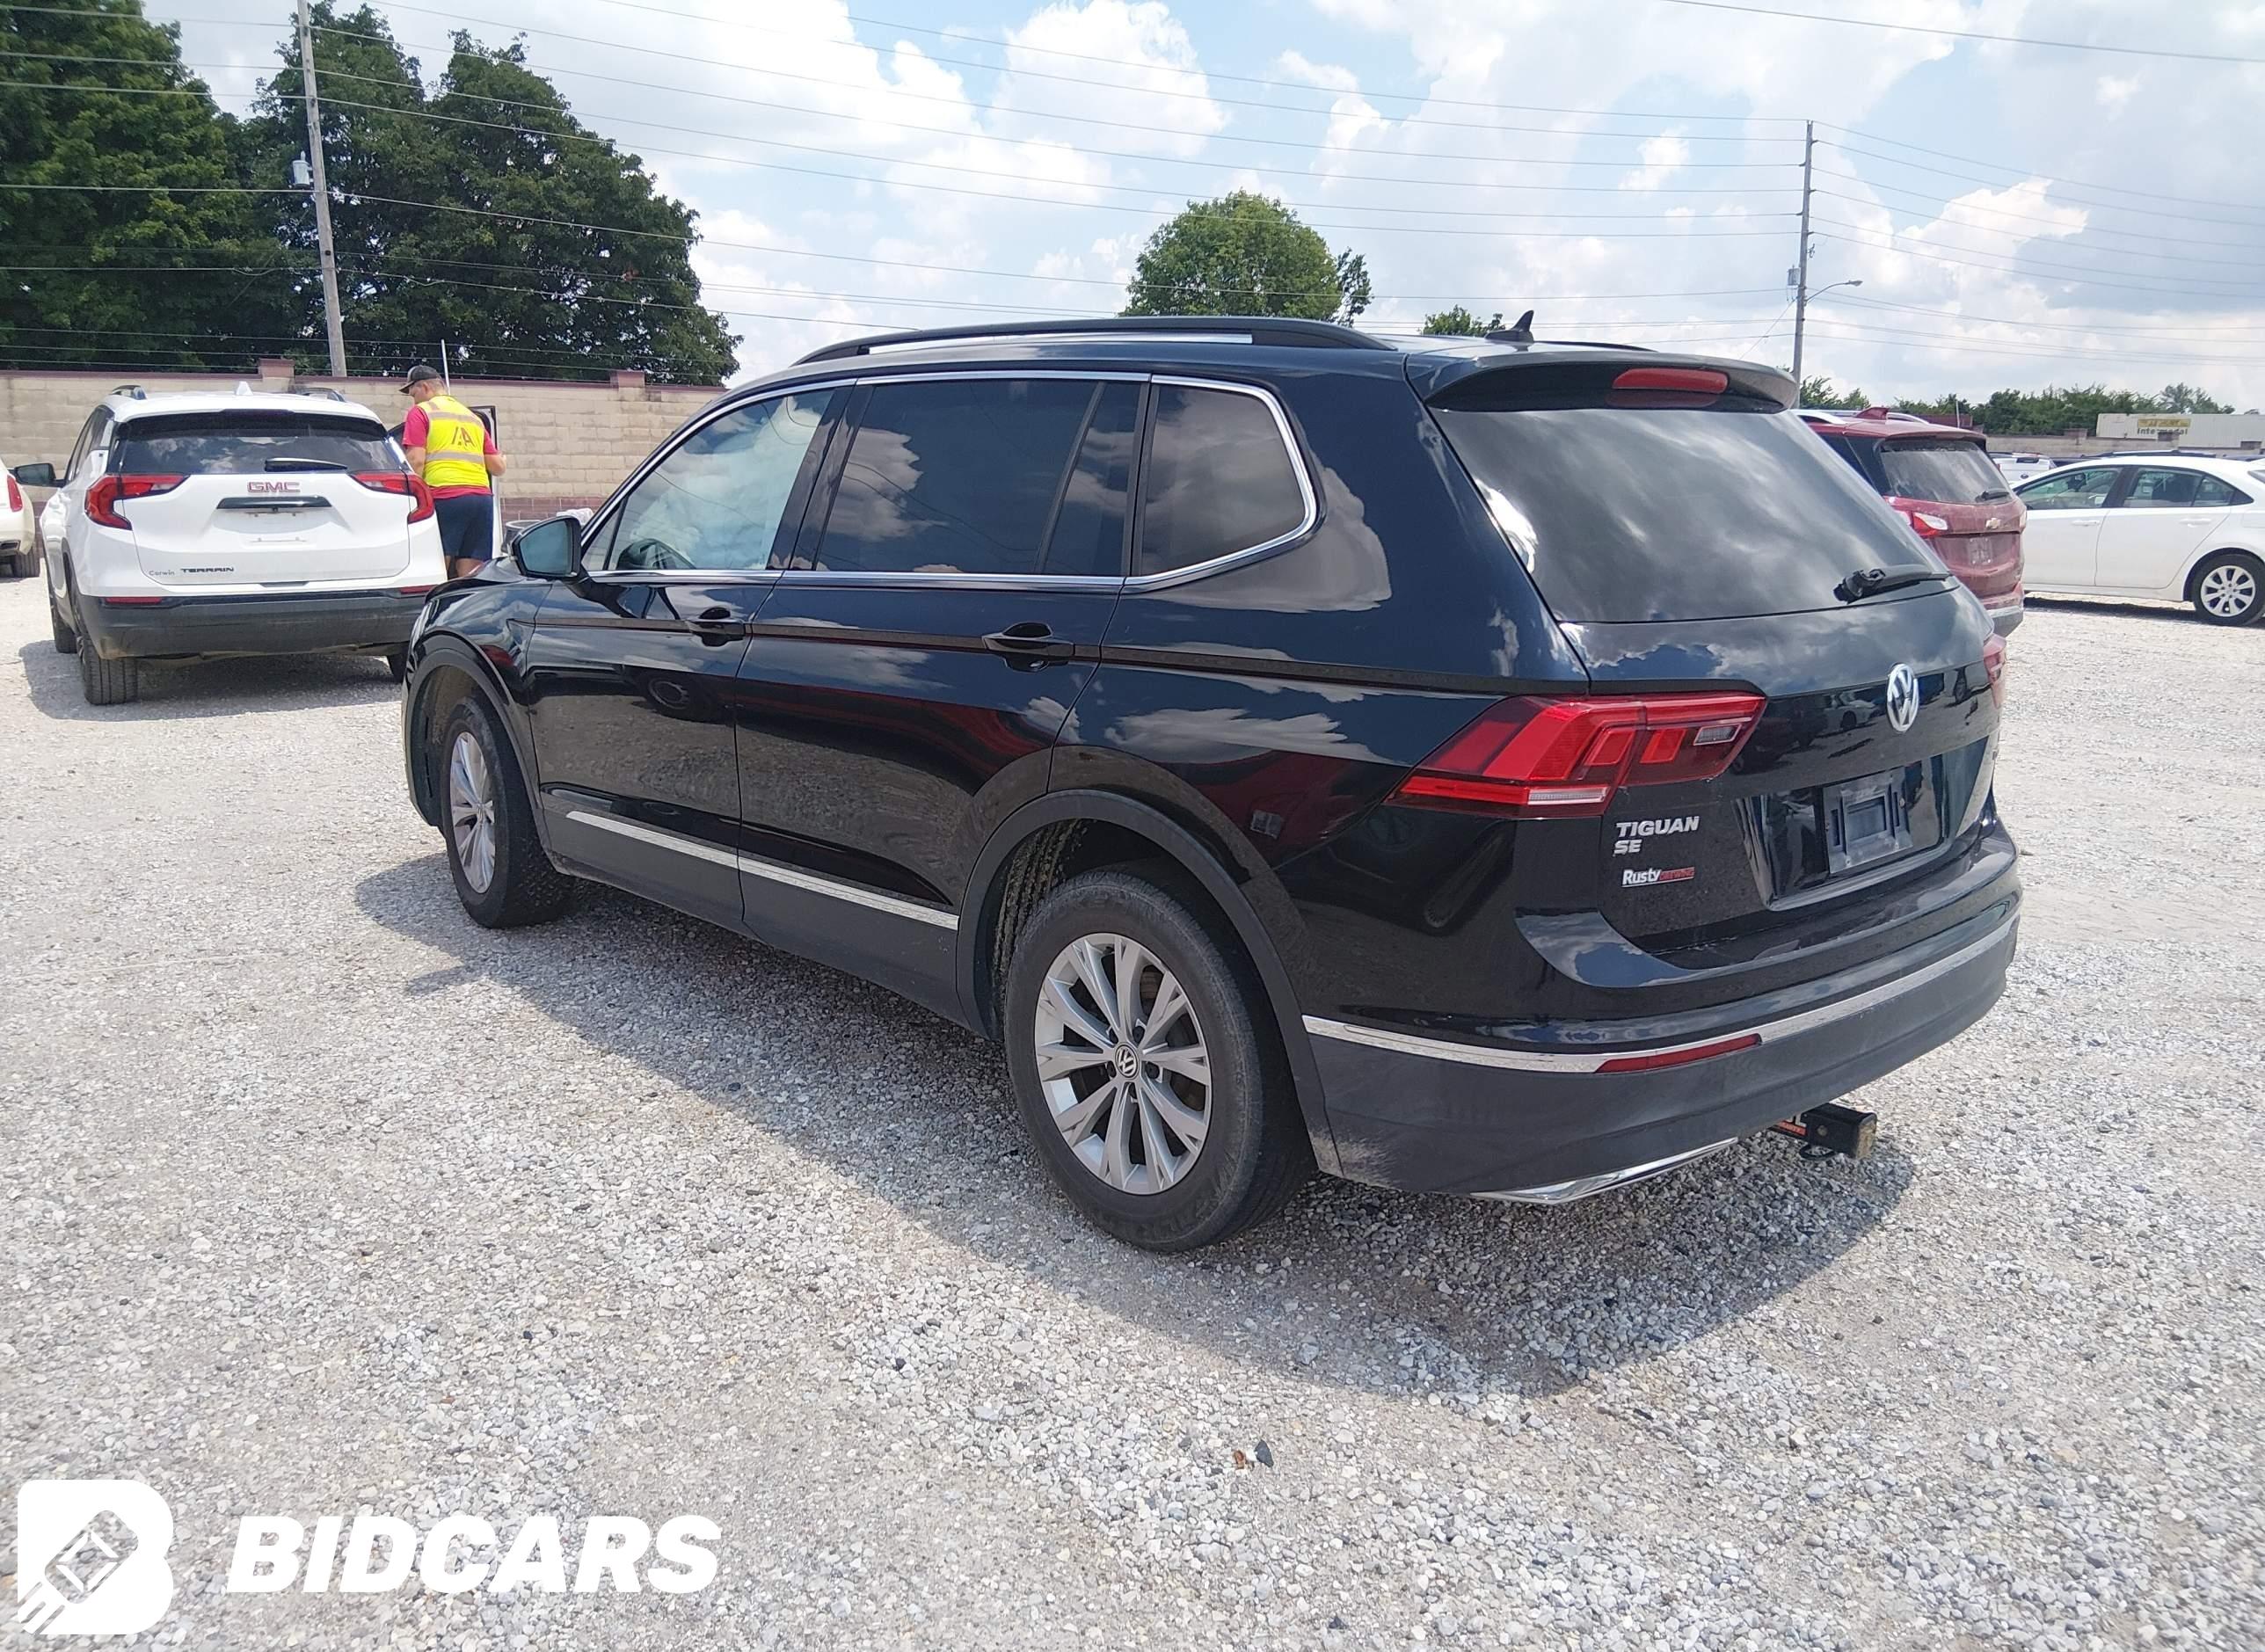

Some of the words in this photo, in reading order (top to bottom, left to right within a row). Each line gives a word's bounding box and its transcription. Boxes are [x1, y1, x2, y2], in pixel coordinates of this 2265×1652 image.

[247, 481, 301, 493] GMC
[1616, 816, 1700, 838] TIGUAN
[1613, 839, 1642, 855] SE
[1622, 868, 1662, 884] Rusty
